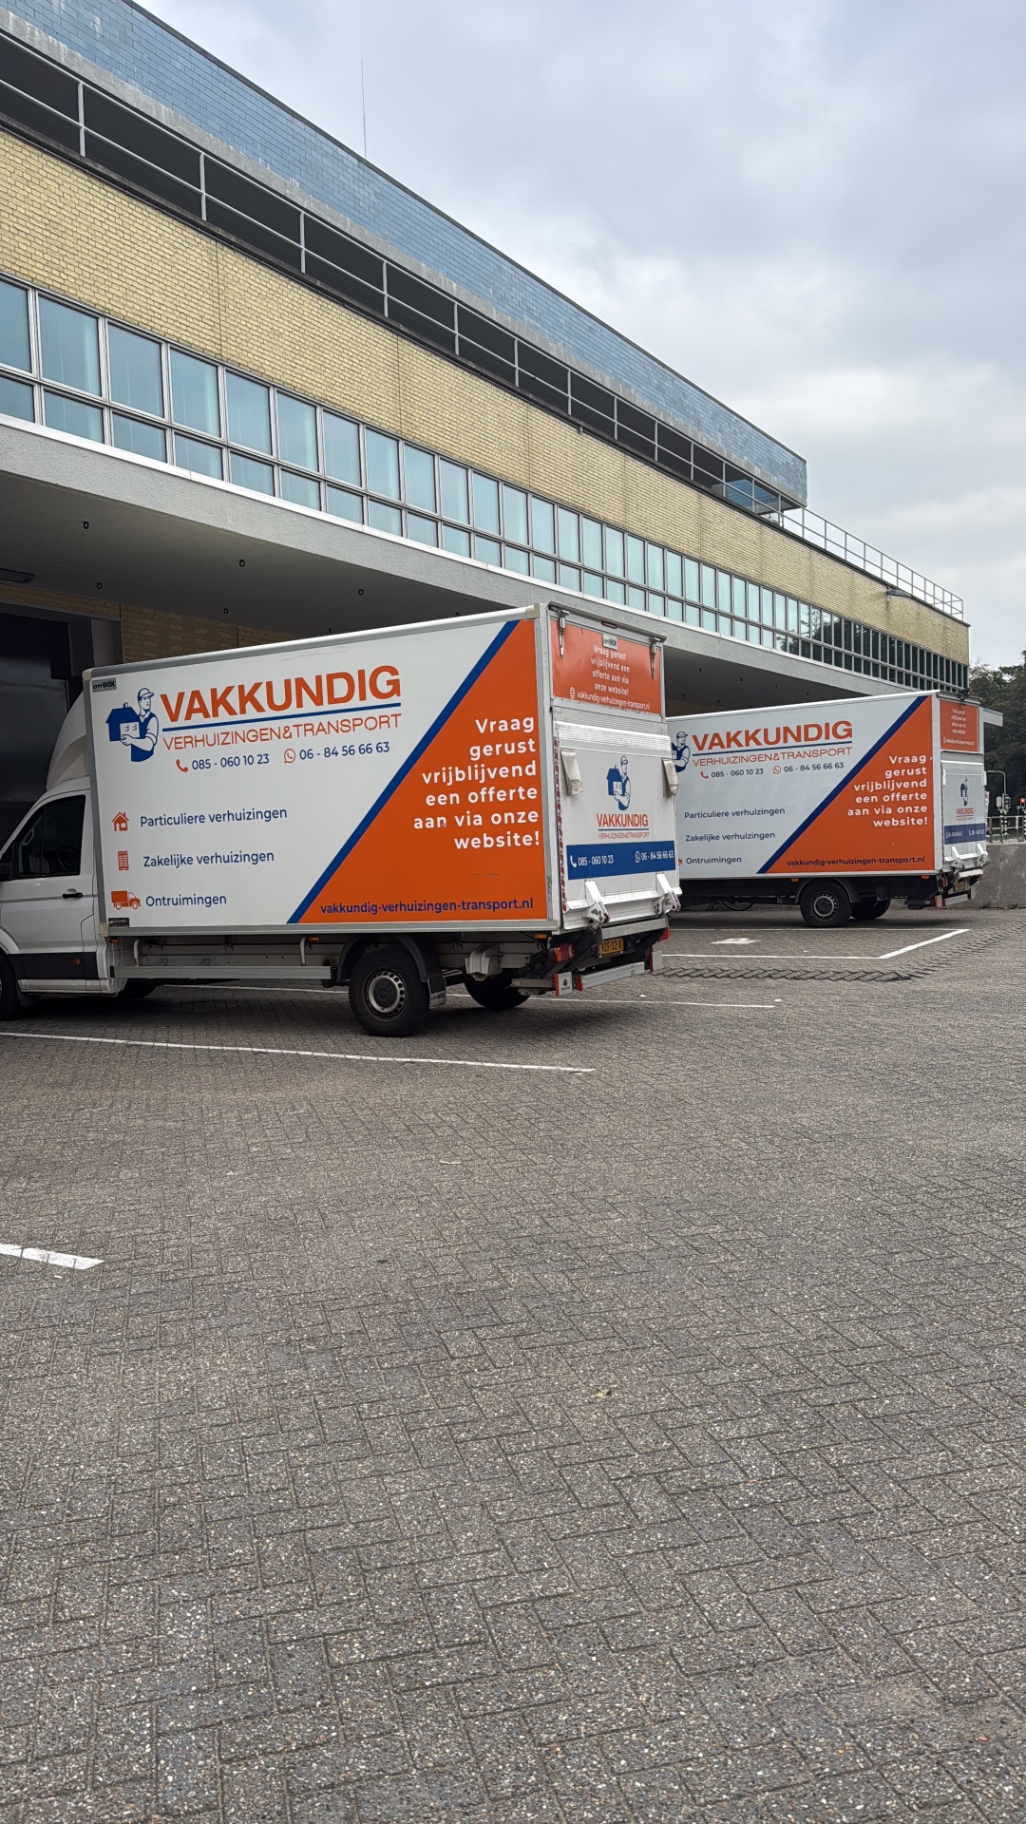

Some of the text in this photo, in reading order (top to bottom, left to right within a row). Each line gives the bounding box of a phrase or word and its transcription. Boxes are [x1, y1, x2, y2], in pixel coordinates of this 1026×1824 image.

[160, 665, 401, 722] VAKKUNDIG
[163, 714, 401, 750] VERHUIZINGEN&TRANSPORT
[475, 717, 534, 734] Vraag
[692, 720, 852, 751] VAKKUNDIG
[299, 748, 314, 760] 06
[324, 746, 338, 758] 84
[342, 745, 355, 756] 56
[358, 743, 372, 755] 66
[376, 742, 390, 753] 63
[470, 738, 536, 761] gerust
[693, 747, 852, 767] VERHUIZINGEN&TRANSPORT
[192, 759, 211, 770] 085
[220, 756, 242, 768] 060
[243, 755, 254, 766] 10
[256, 754, 269, 765] 23
[889, 755, 926, 764] Vraag
[422, 761, 536, 786] vrijblijvend
[885, 768, 926, 778] gerust
[854, 779, 926, 791] vrijblijvend
[426, 786, 538, 806] een offerte
[856, 792, 927, 803] een offerte
[140, 807, 287, 827] Particuliere verhuizingen
[685, 808, 785, 819] Particuliere verhuizingen
[847, 808, 869, 816] aan
[874, 806, 892, 815] via
[414, 811, 538, 829] aan via onze
[596, 814, 648, 827] VAKKUNDIG
[873, 817, 928, 827] website!
[454, 832, 540, 849] website!
[685, 832, 775, 842] Zakelijke verhuizingen
[143, 851, 274, 869] Zakelijke verhuizingen
[686, 856, 742, 865] Ontruimingen
[787, 857, 925, 866] vakkundig-verhuizingen-transport.nl
[145, 894, 227, 908] Ontruimingen
[321, 898, 533, 915] vakkundig-verhuizingen-transport.nl
